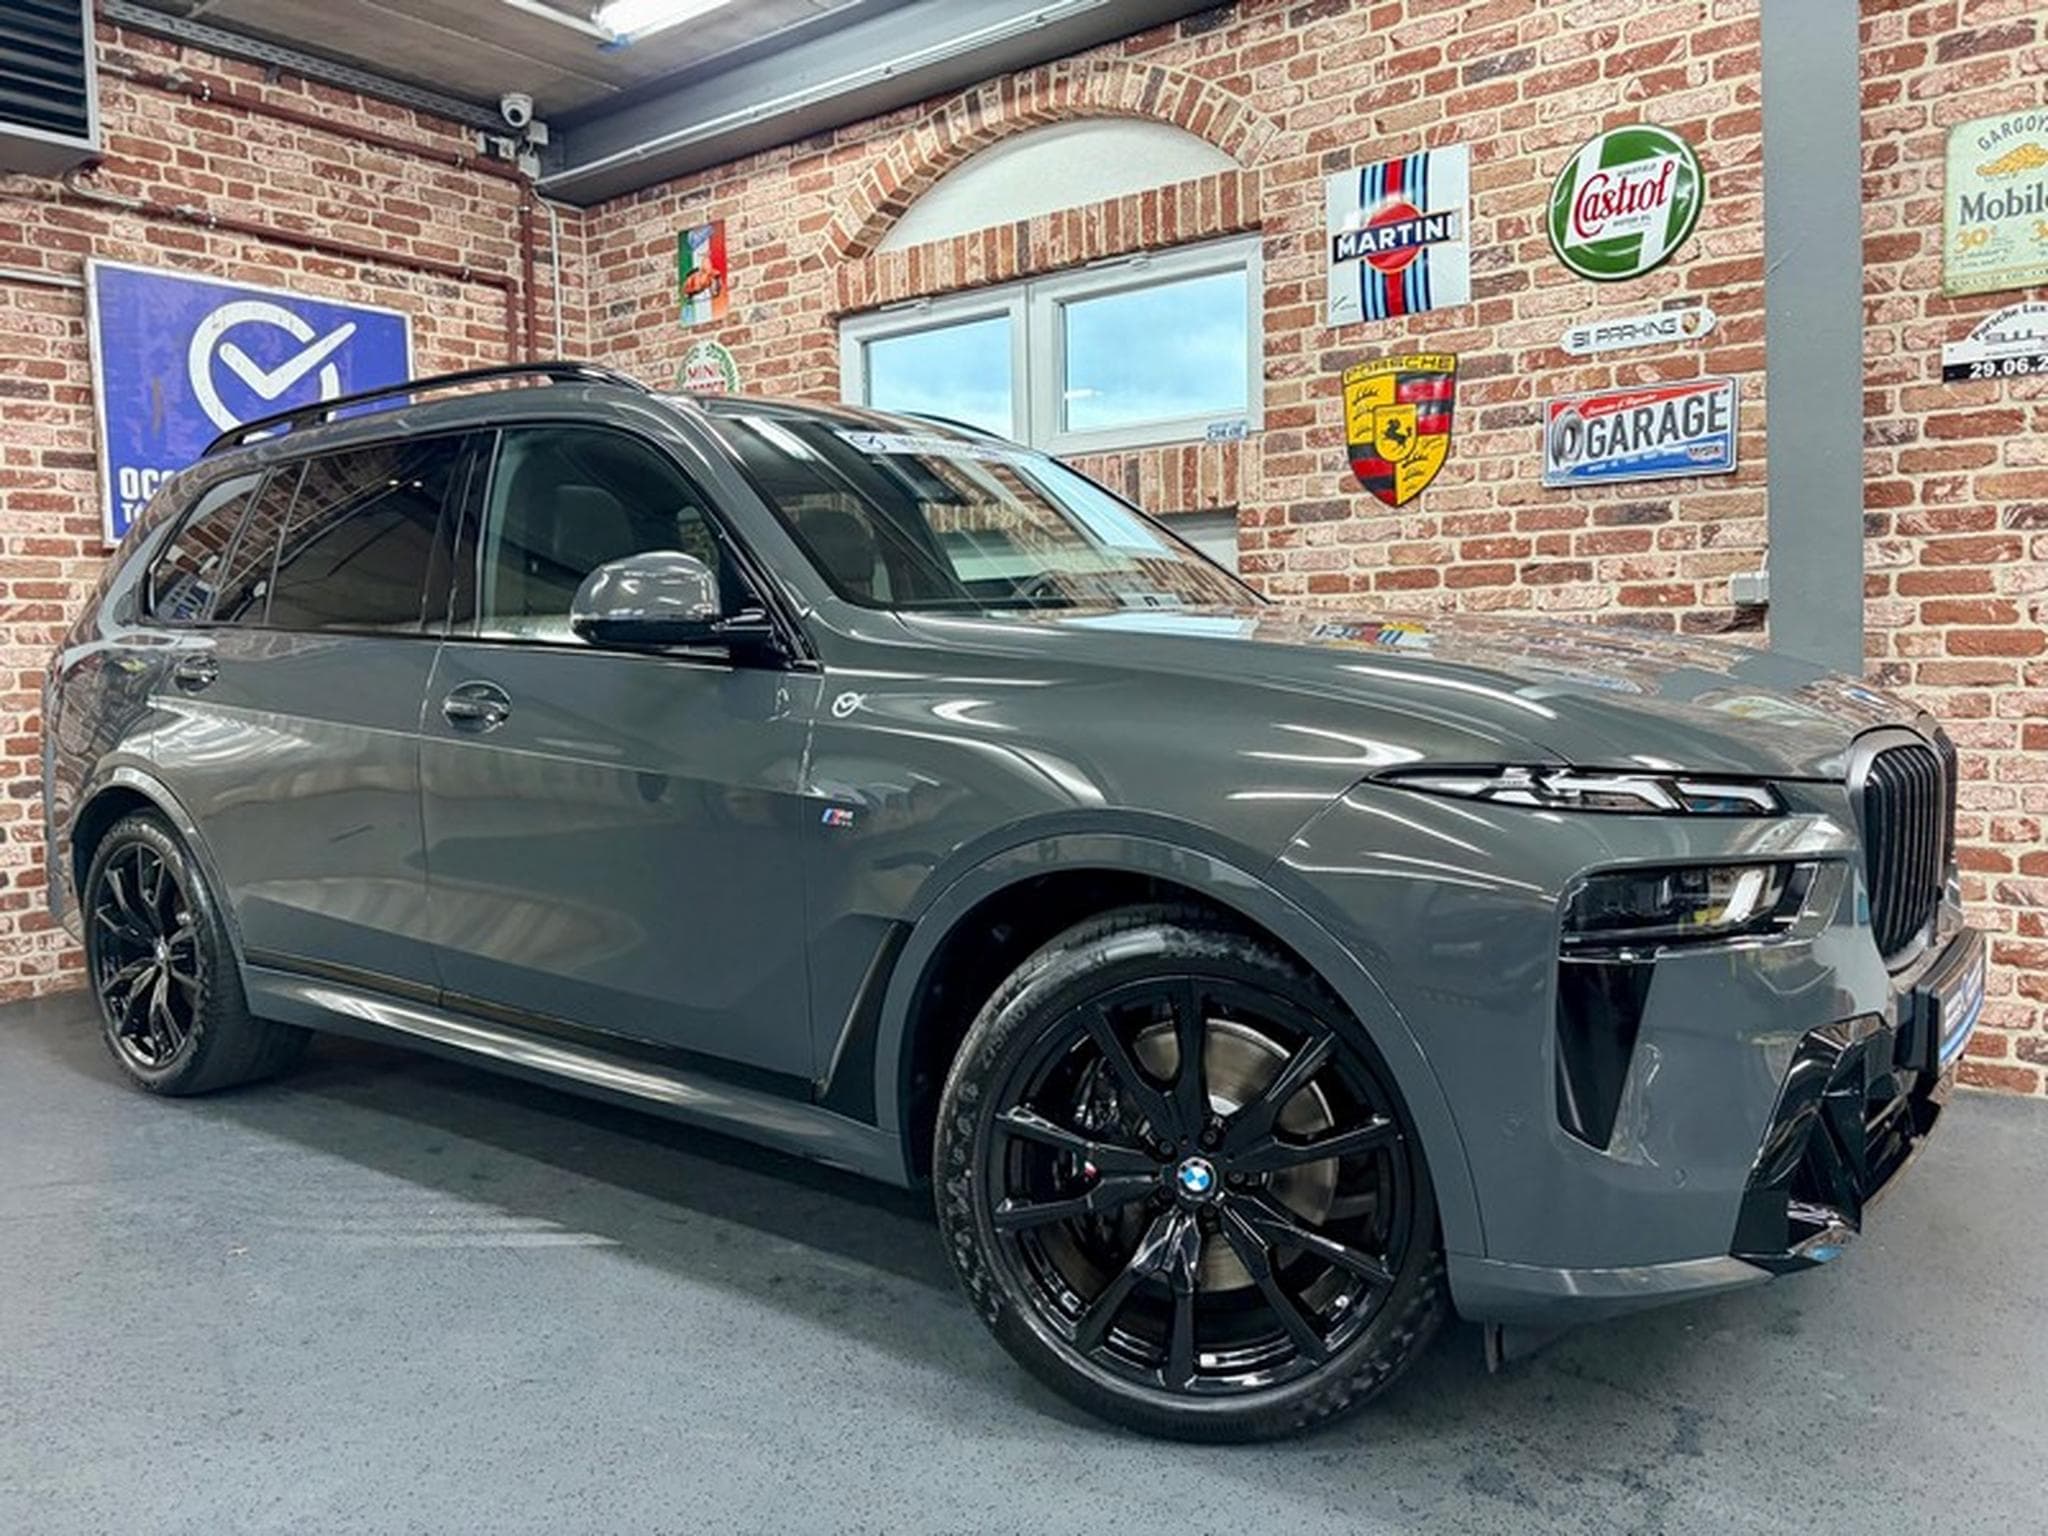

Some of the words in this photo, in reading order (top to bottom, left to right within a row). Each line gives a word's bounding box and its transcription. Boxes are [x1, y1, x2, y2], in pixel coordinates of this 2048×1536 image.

[1977, 115, 2048, 151] GARGOY
[1573, 160, 1674, 238] Castrol
[1959, 182, 2048, 226] Mobil
[1337, 214, 1453, 258] MARTINI
[1595, 318, 1677, 343] PARKING
[1346, 355, 1452, 383] PORSCHE
[1586, 389, 1729, 459] GARAGE
